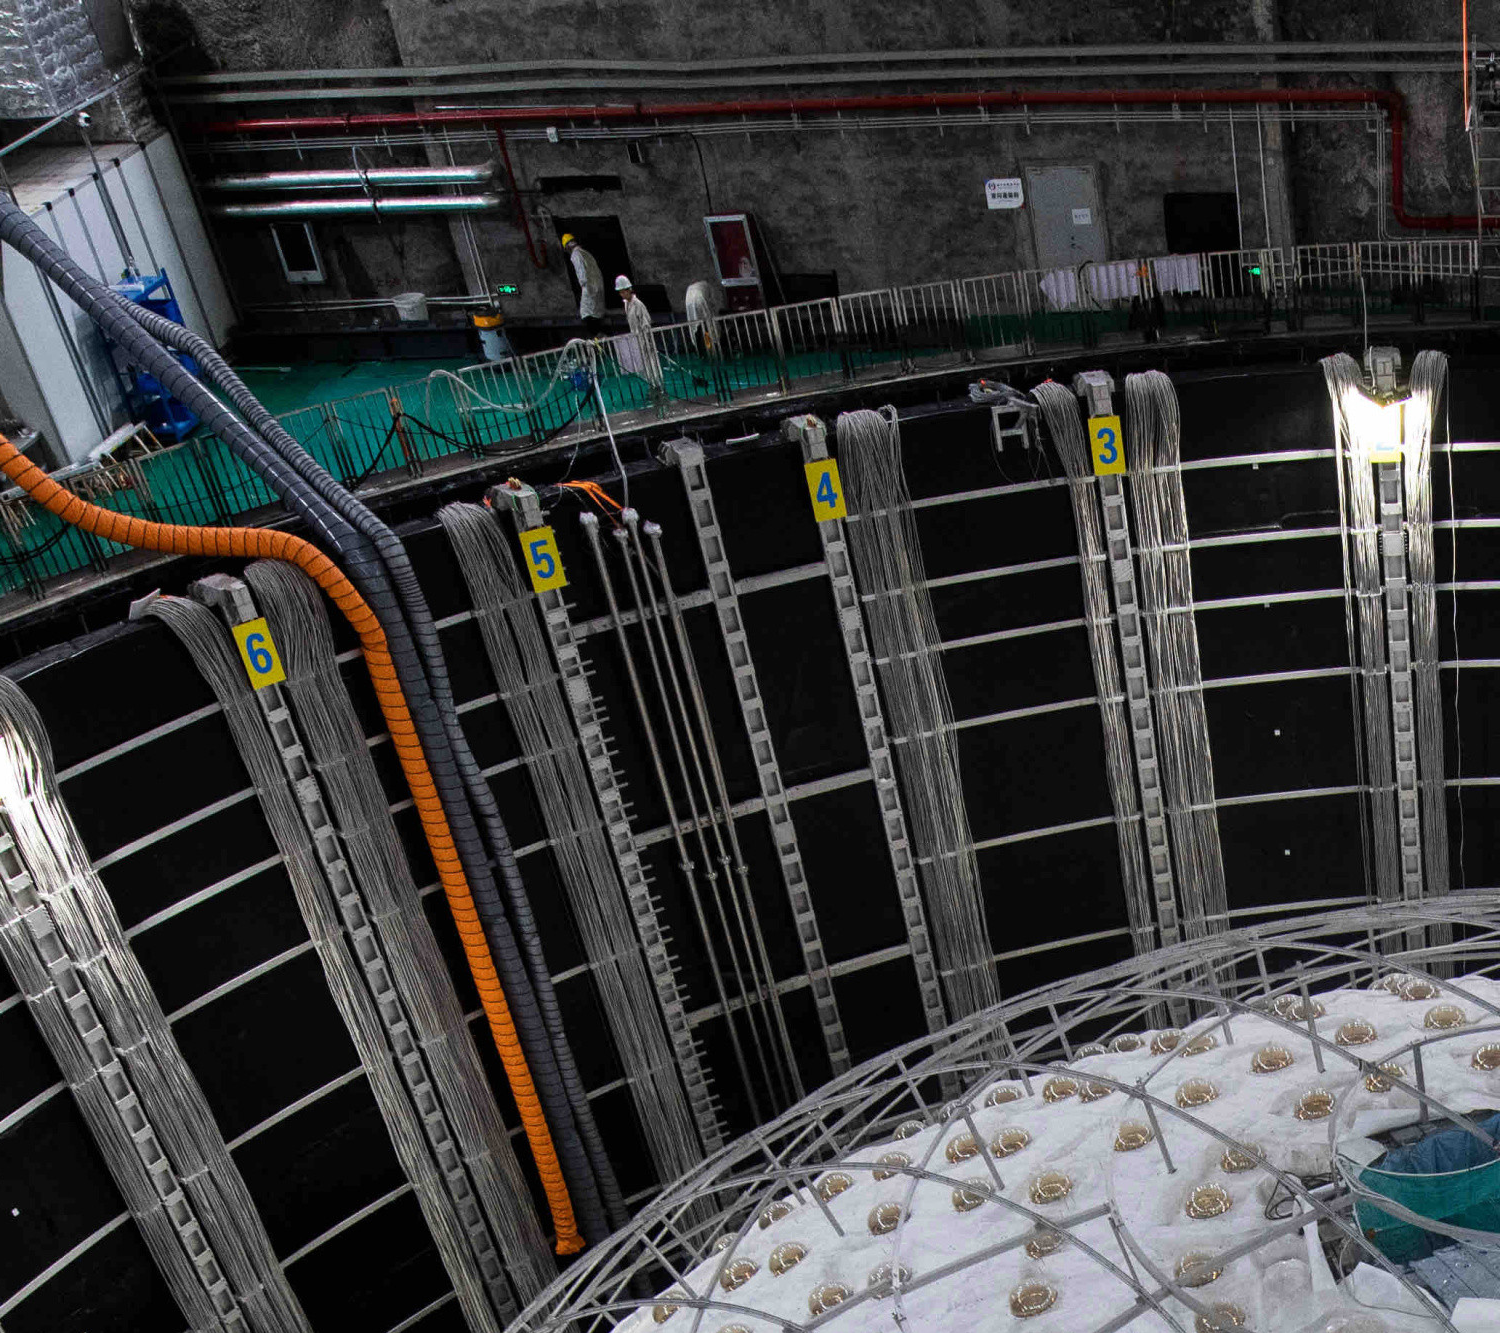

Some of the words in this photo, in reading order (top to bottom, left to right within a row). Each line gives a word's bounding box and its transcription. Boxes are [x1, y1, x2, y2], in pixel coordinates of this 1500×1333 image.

[1097, 427, 1118, 464] 3
[816, 472, 838, 508] 4
[529, 539, 555, 579] 5
[246, 633, 273, 674] 6
